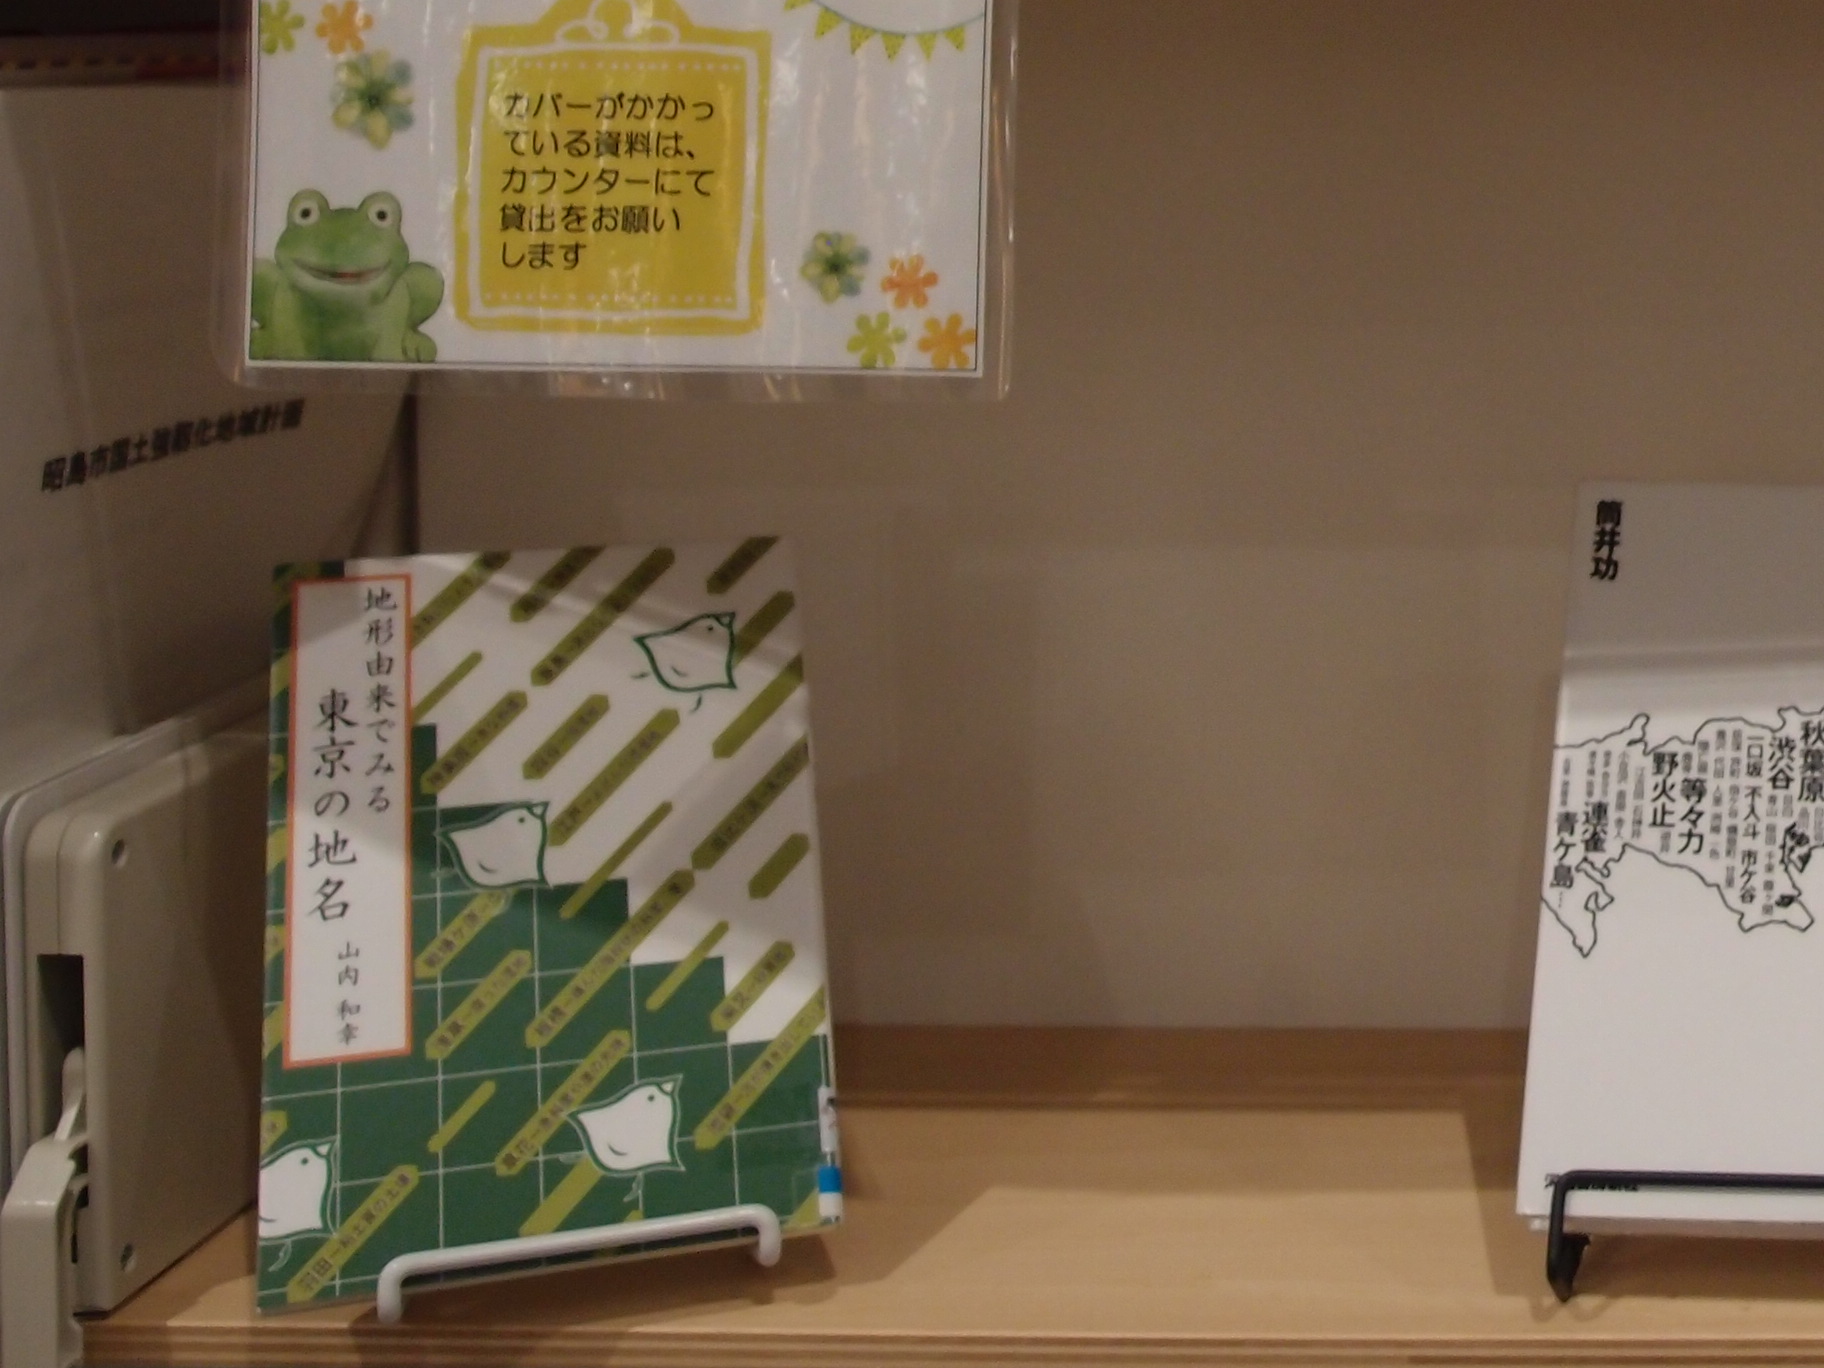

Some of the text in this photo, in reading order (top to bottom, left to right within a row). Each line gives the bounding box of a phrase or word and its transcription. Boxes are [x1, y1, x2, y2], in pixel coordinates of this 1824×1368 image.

[505, 92, 714, 121] カバーがかかっ
[504, 130, 694, 158] ている資料は、
[501, 167, 714, 196] カウンターにて
[500, 205, 680, 234] 貸出をお願い
[502, 241, 586, 270] します
[365, 587, 397, 814] 地形由来でみる
[1769, 736, 1796, 789] 渋谷
[308, 689, 358, 921] 東京の地名
[1649, 751, 1678, 827] 野火止
[1678, 778, 1707, 854] 等々力
